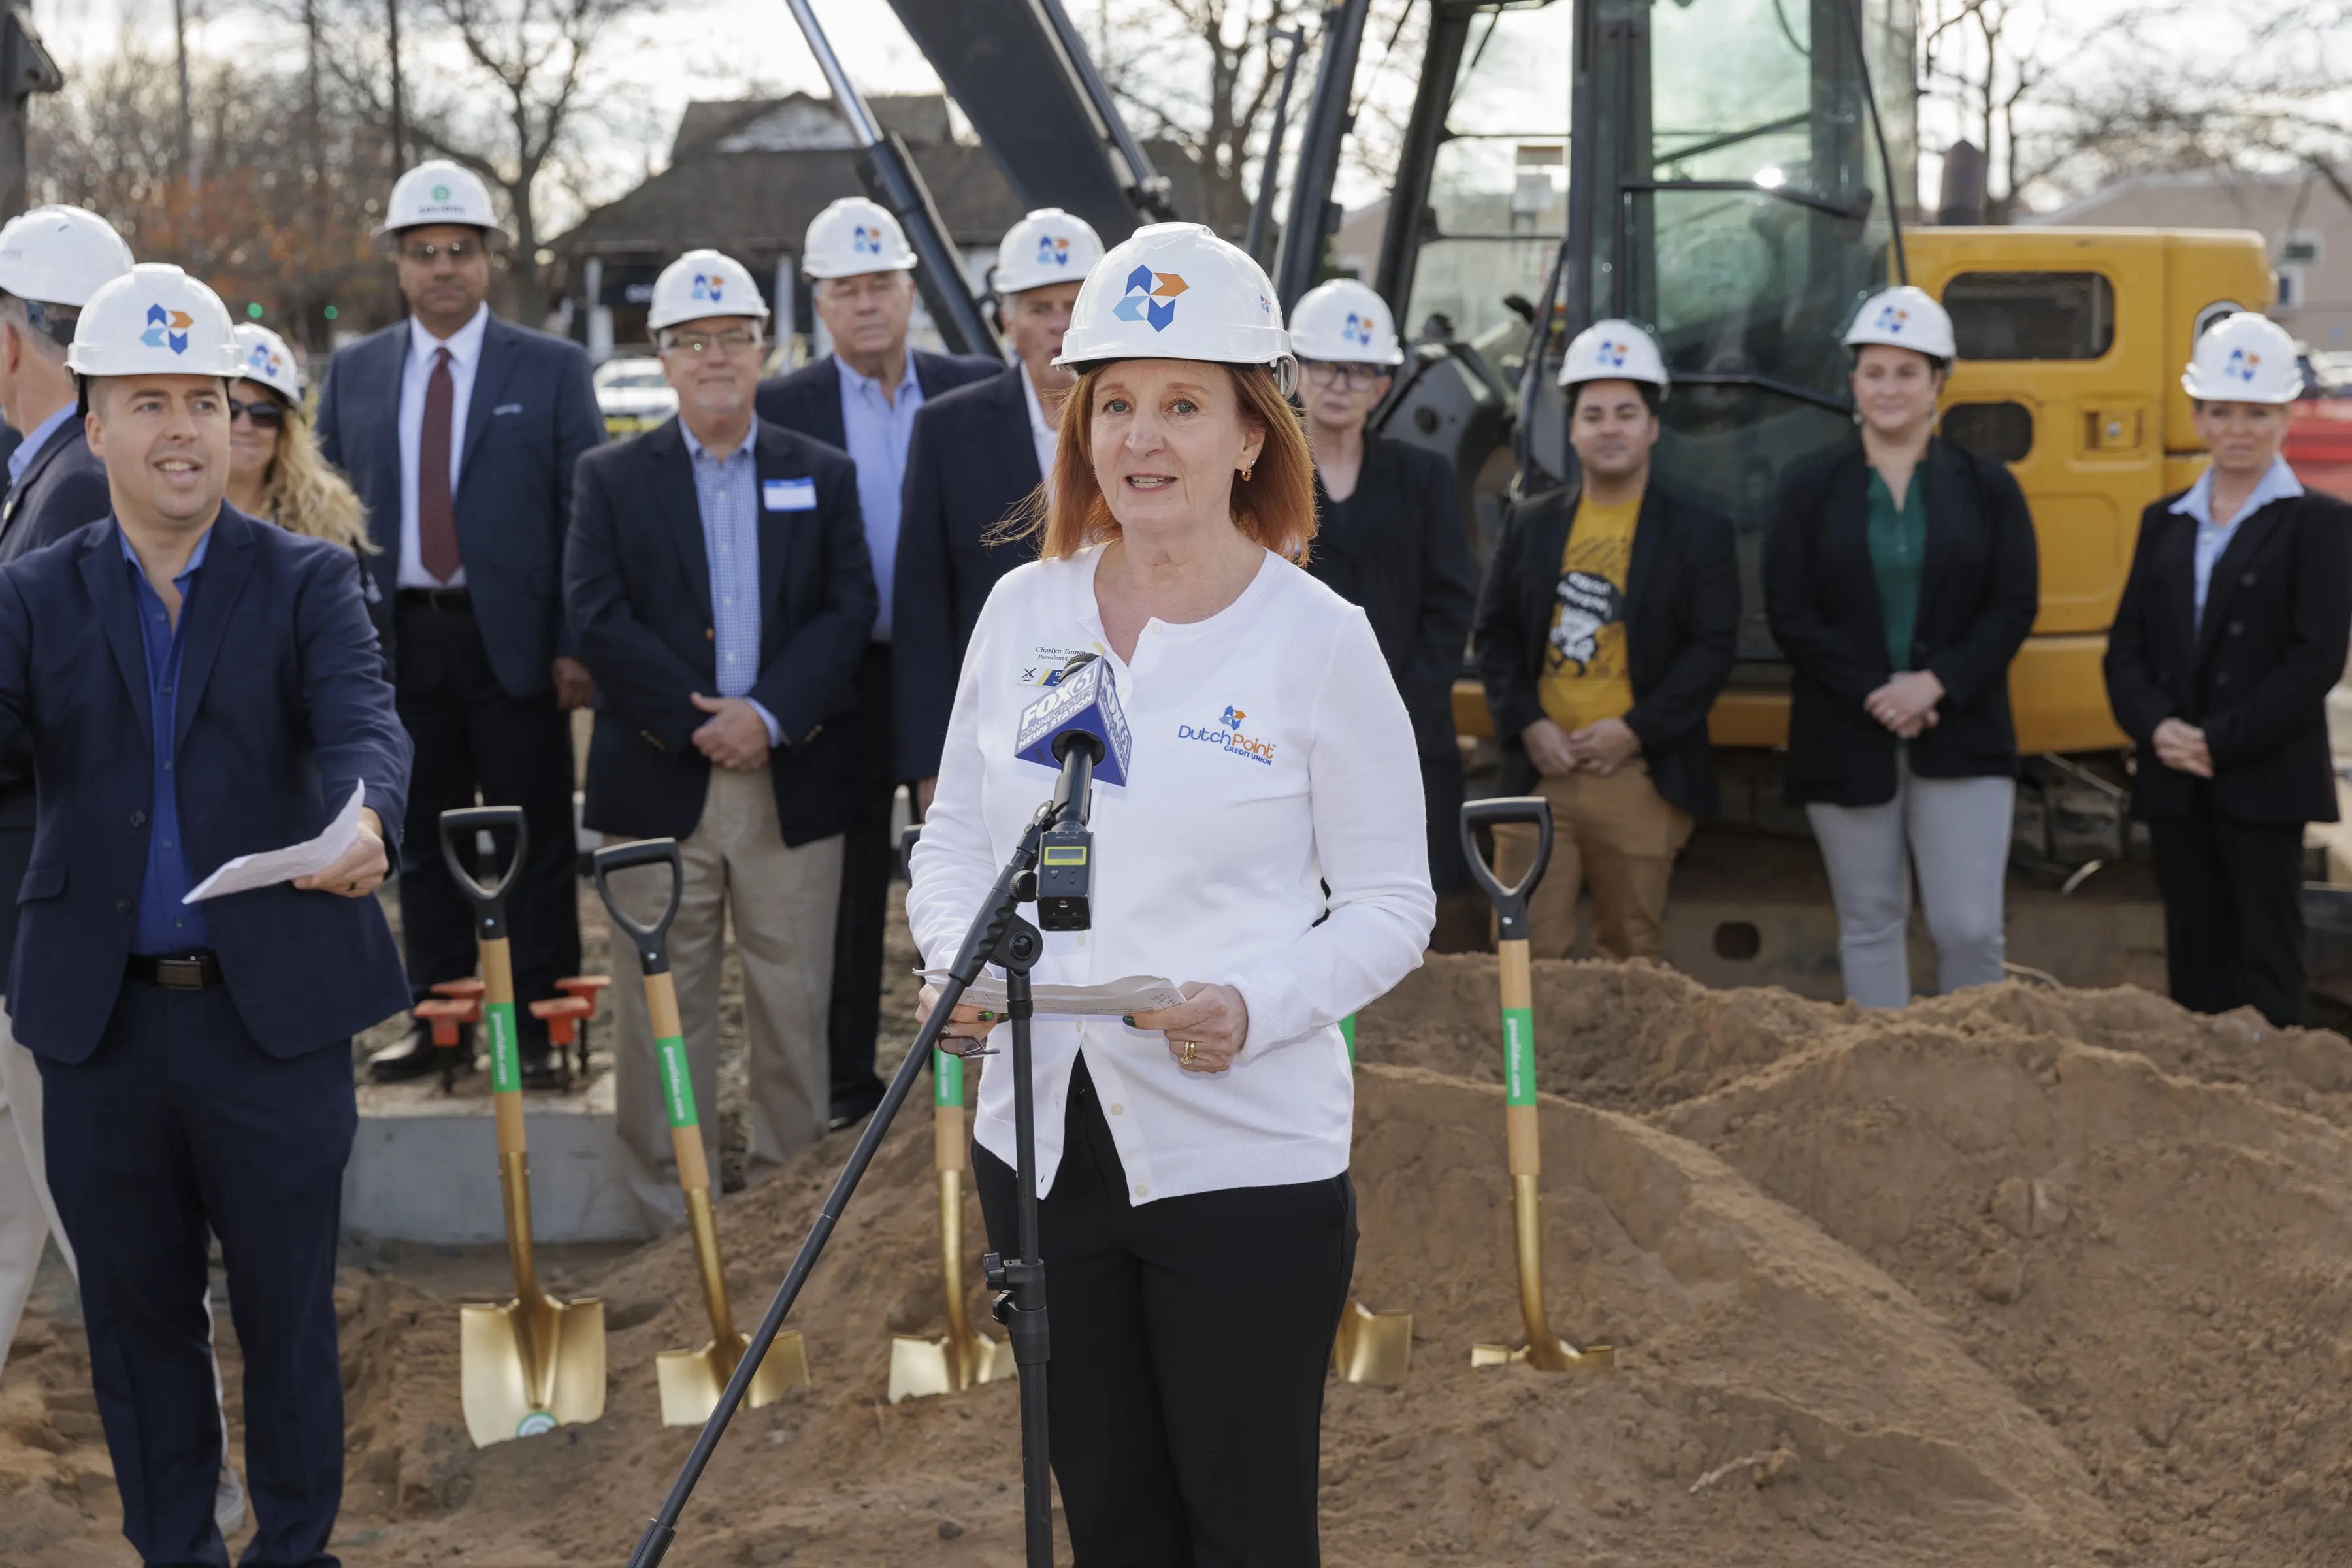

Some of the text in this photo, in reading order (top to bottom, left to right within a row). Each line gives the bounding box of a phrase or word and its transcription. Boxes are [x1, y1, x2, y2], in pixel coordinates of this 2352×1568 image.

[1018, 693, 1093, 749] NEWS STATION
[1020, 684, 1094, 740] CONNECTICUT'S
[1224, 745, 1272, 766] CREDIT UNION
